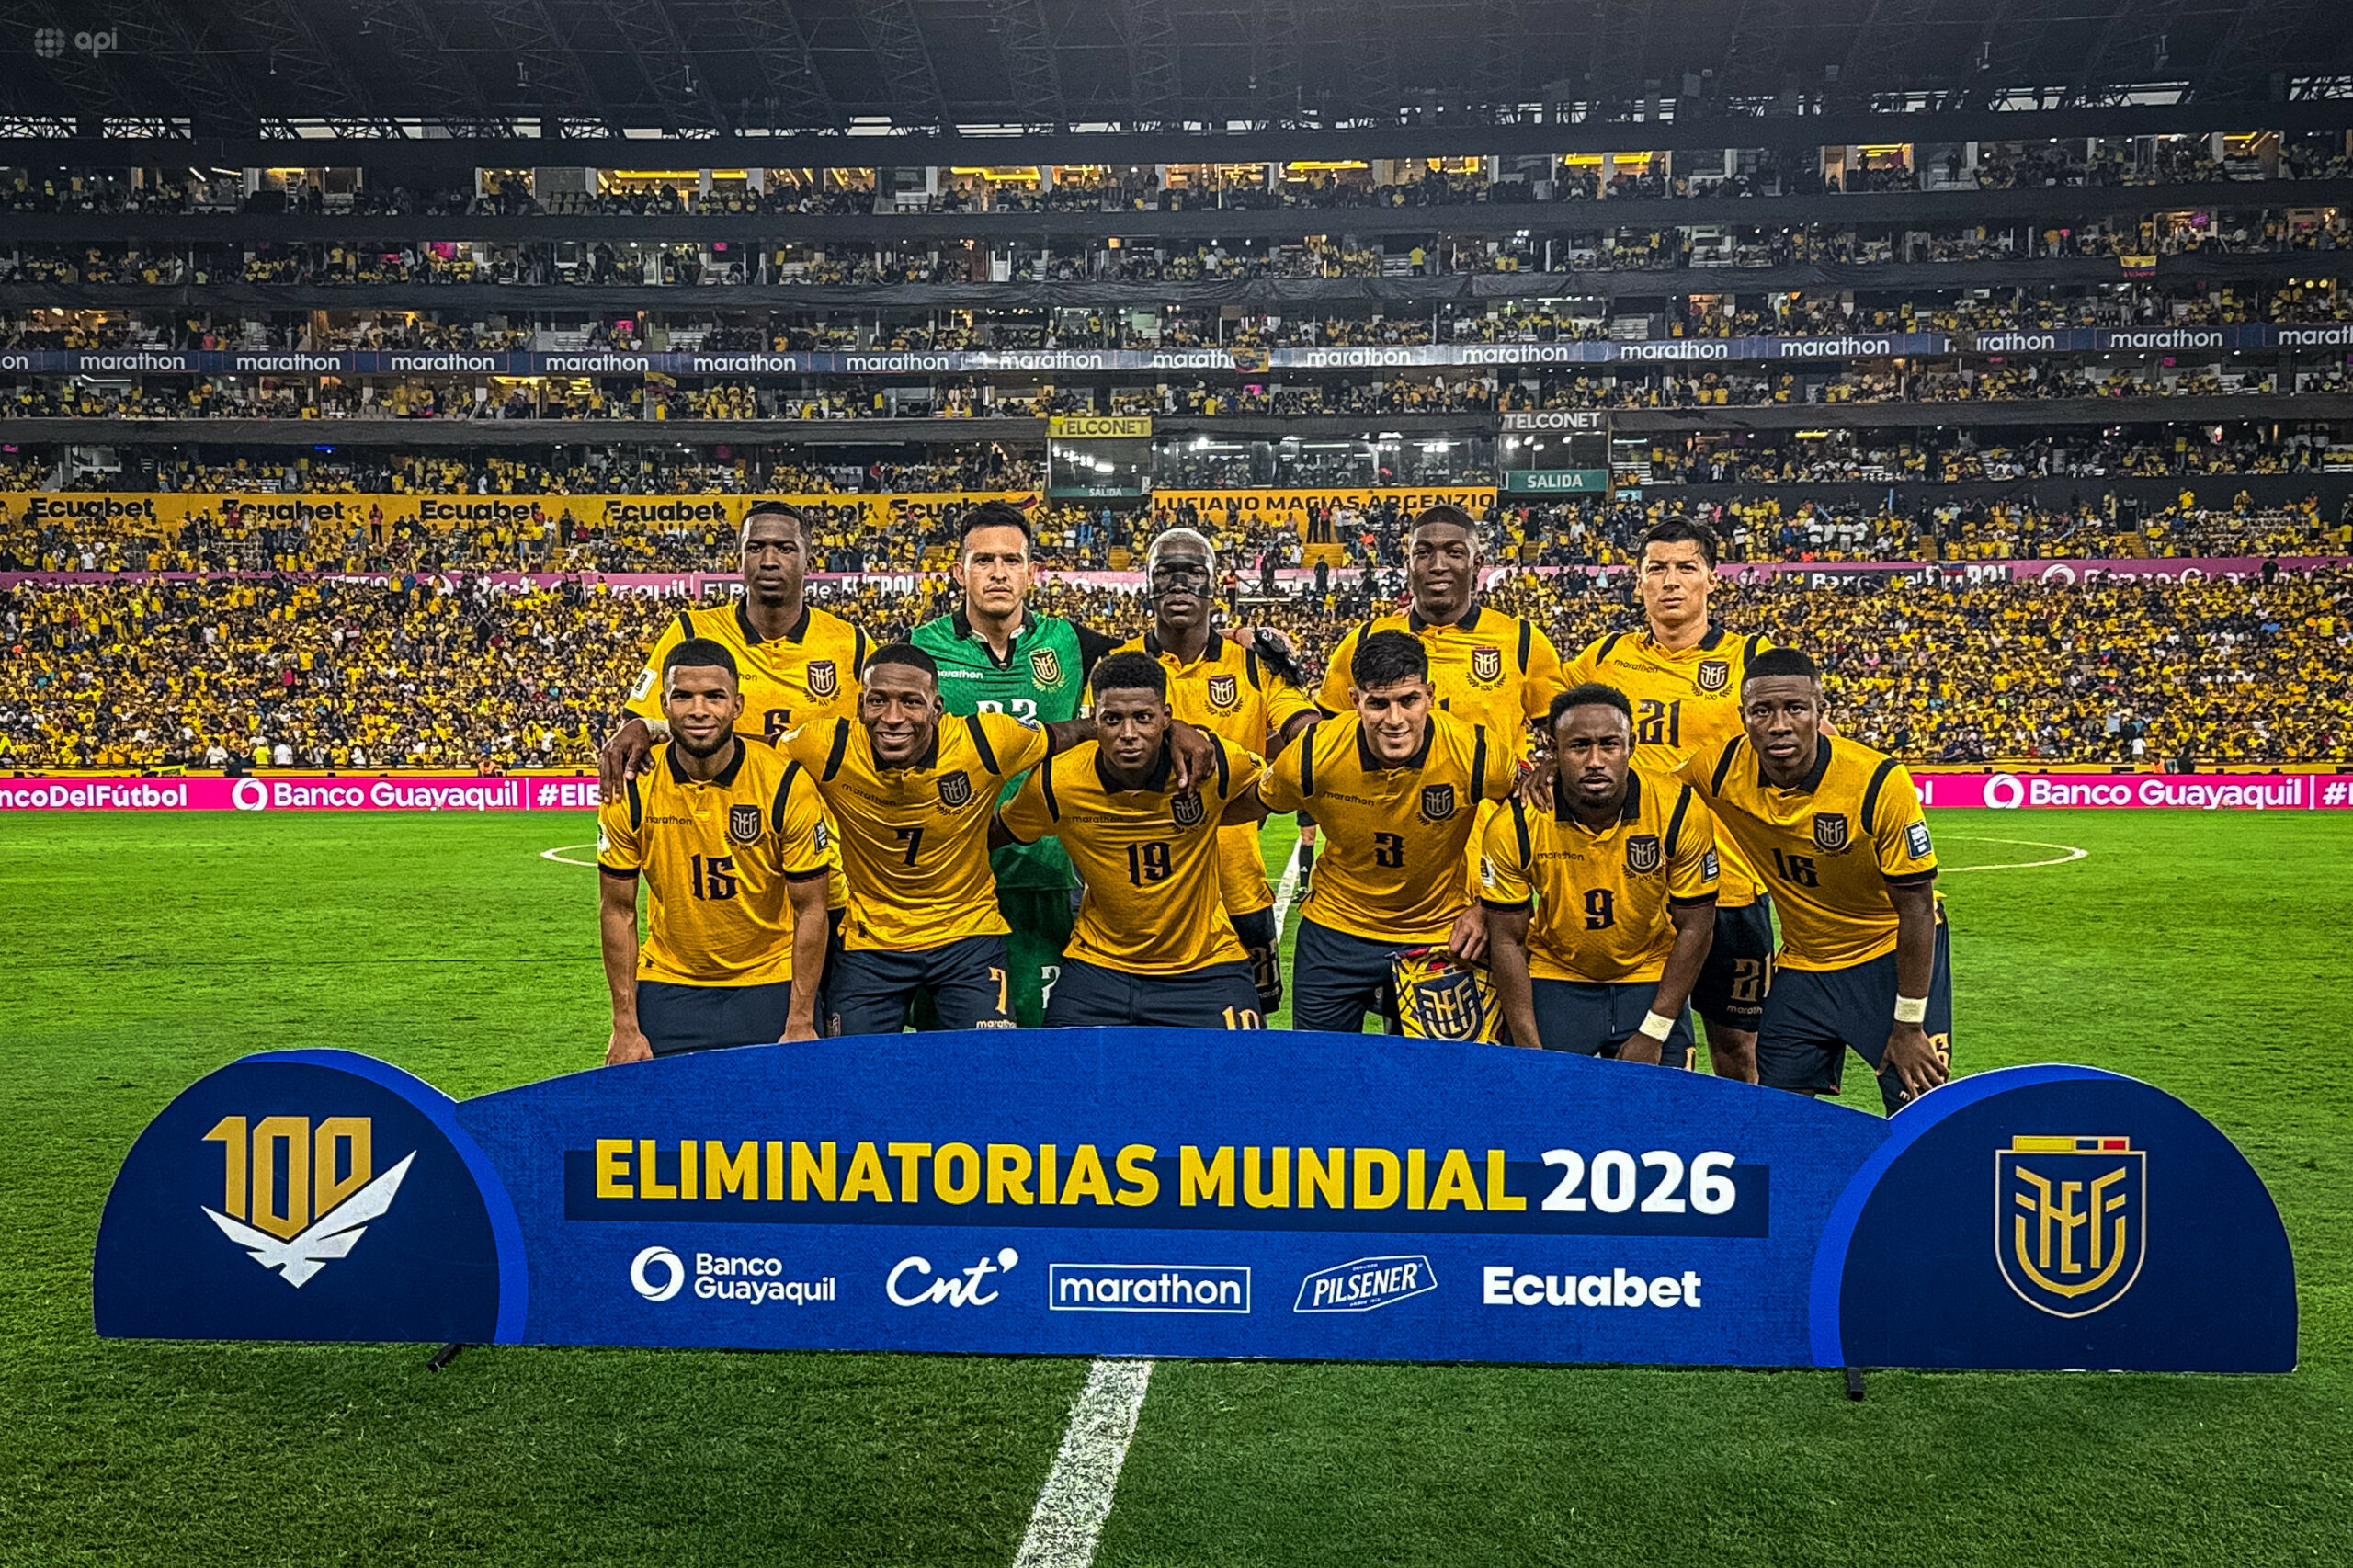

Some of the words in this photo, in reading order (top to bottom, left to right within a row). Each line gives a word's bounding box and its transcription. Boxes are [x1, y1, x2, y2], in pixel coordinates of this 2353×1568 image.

[1620, 338, 1728, 360] marathon
[1780, 334, 1890, 357] marathon
[2110, 329, 2223, 349] marathon
[80, 351, 186, 370] marathon
[236, 352, 341, 371] marathon
[391, 352, 495, 371] marathon
[545, 353, 650, 371] marathon
[693, 354, 797, 372] marathon
[847, 353, 949, 371] marathon
[999, 351, 1102, 370] marathon
[1153, 348, 1235, 369] marath
[1306, 345, 1411, 366] marathon
[1462, 343, 1568, 363] marathon
[1505, 412, 1601, 429] TELCONET
[1088, 487, 1122, 497] SALIDA
[1527, 474, 1583, 488] SALIDA
[30, 497, 154, 518] Ecuabet
[421, 499, 542, 522] Ecuabet
[606, 500, 722, 522] Ecuabet
[1154, 496, 1255, 511] LUCIANO
[1613, 658, 1659, 674] marathon
[1638, 699, 1681, 748] 21
[274, 782, 365, 808] Banco
[370, 780, 518, 811] Guayaquil
[841, 783, 897, 807] marathon
[1324, 790, 1375, 807] marathon
[2029, 780, 2131, 806] Banco
[2139, 778, 2301, 810] Guayaquil
[645, 814, 693, 826] marathon
[1072, 814, 1124, 824] marathon
[894, 827, 924, 867] 7
[1373, 832, 1404, 868] 3
[1126, 841, 1173, 887] 19
[1771, 847, 1821, 888] 16
[690, 853, 737, 901] 15
[1583, 888, 1617, 930] 9
[988, 966, 1007, 1015] 7
[201, 1116, 372, 1240] 100
[596, 1139, 1160, 1206] ELIMINATORIAS
[1179, 1145, 1528, 1211] MUNDIAL
[1540, 1148, 1737, 1215] 2026
[696, 1252, 783, 1277] Banco
[694, 1277, 836, 1306] Guayaquil
[1059, 1272, 1242, 1306] marathon
[1313, 1262, 1418, 1307] PILSENER
[1483, 1265, 1701, 1309] Ecuabet
